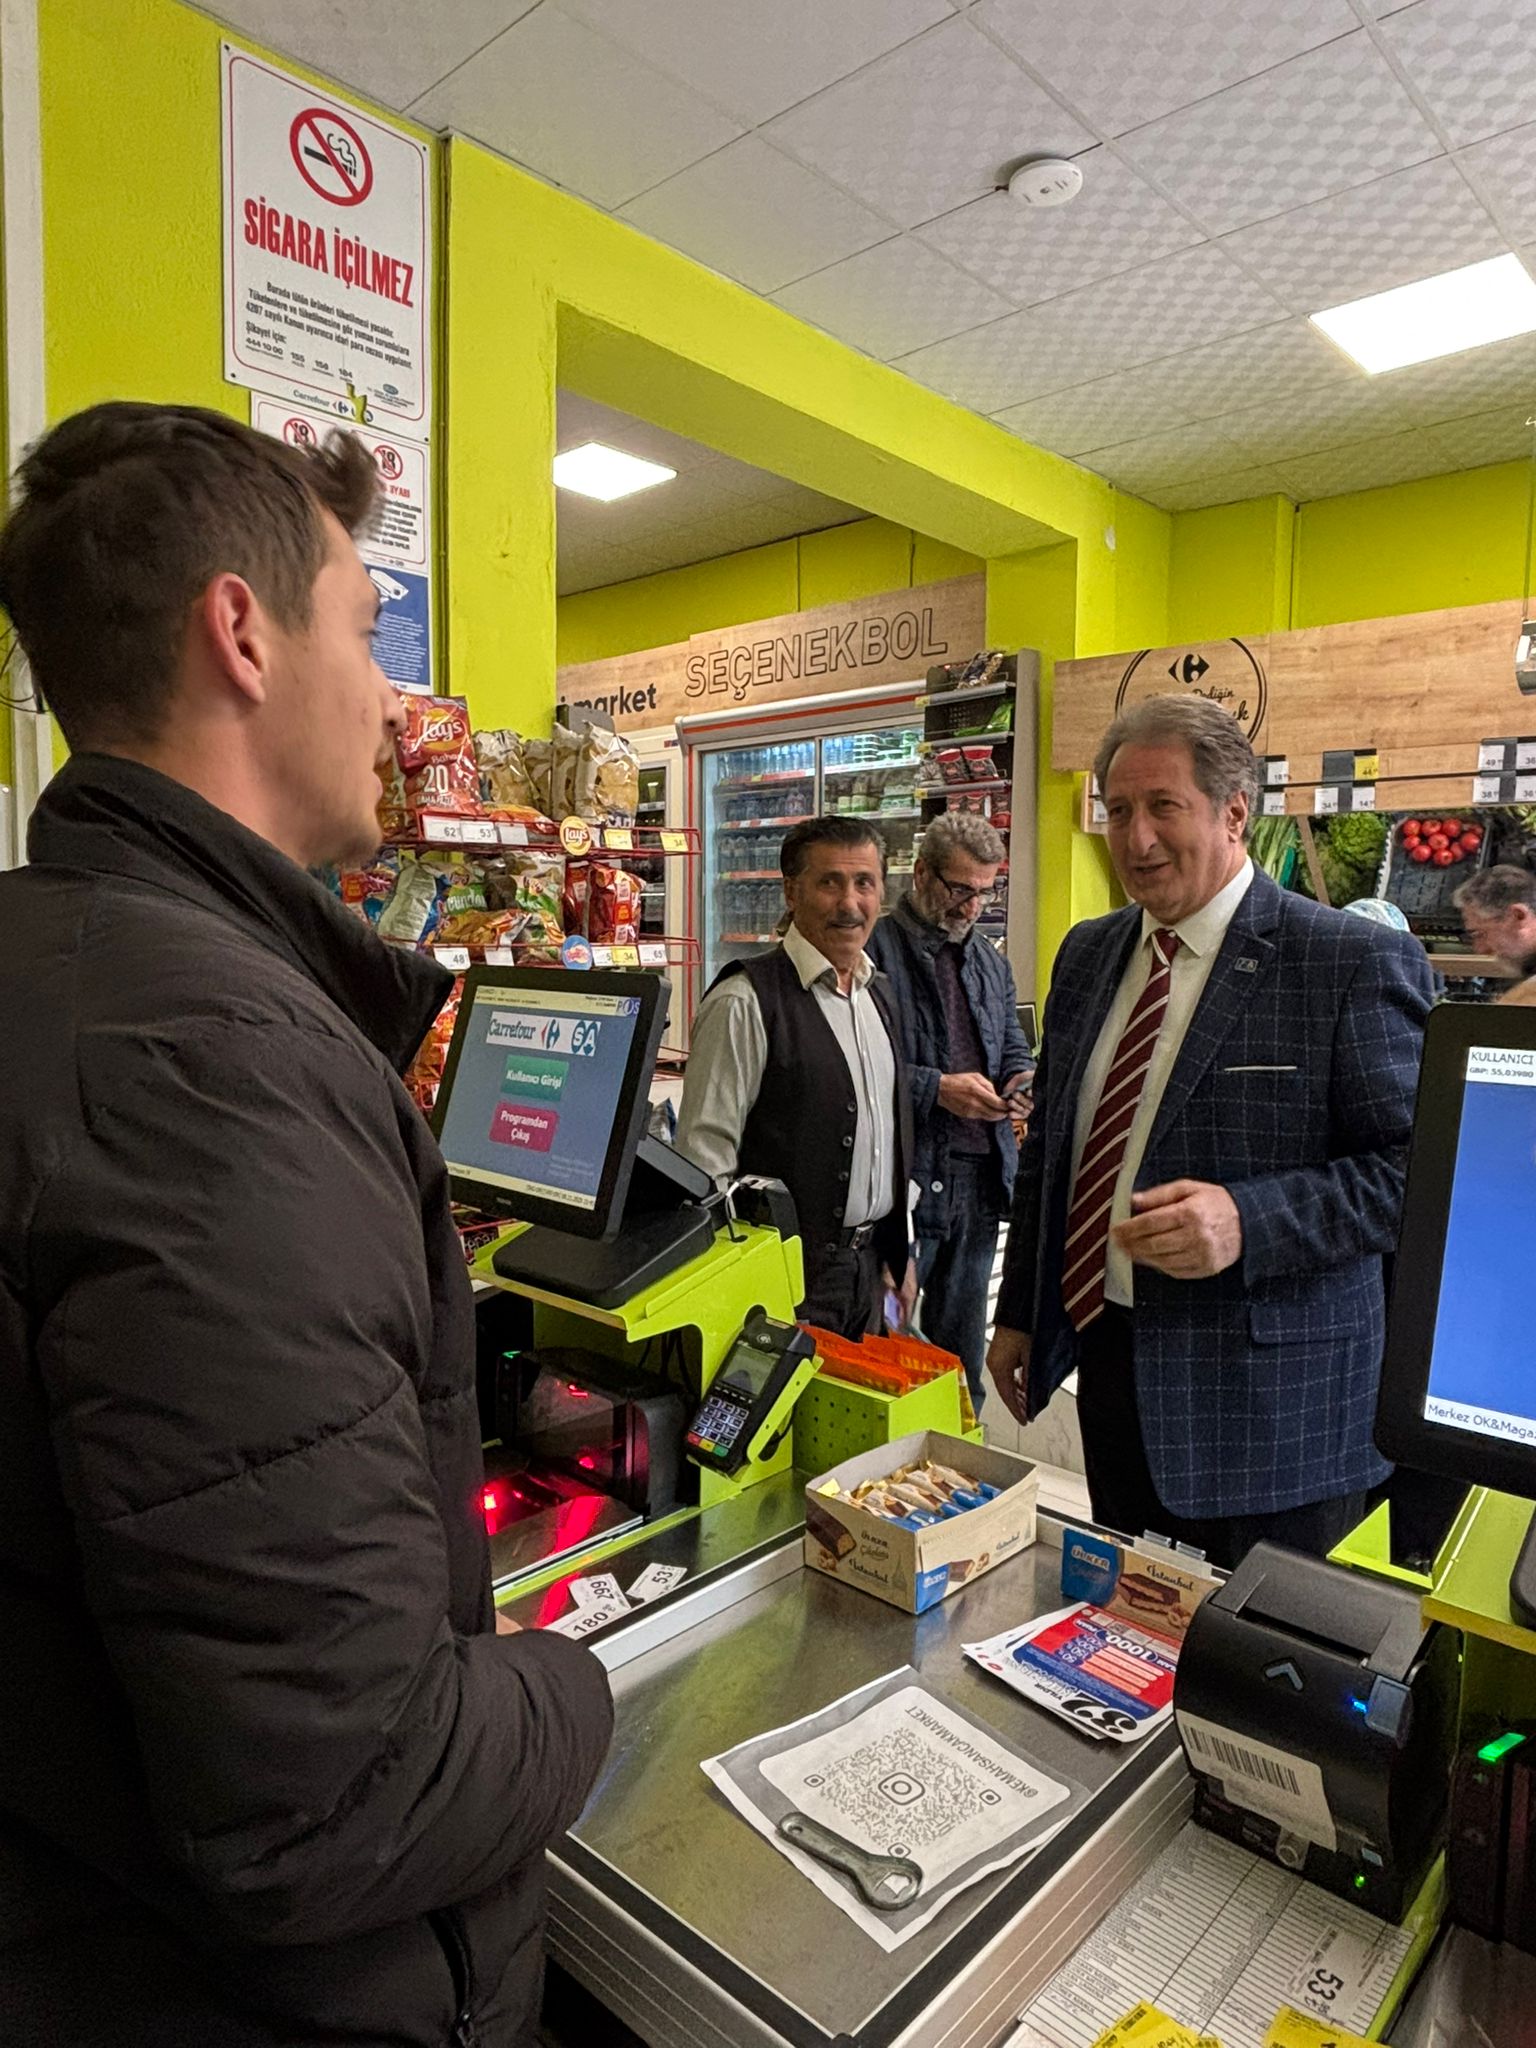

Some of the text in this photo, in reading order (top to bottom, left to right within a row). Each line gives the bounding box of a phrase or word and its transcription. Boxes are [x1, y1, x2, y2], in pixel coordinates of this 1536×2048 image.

[244, 196, 414, 308] SİGARA İÇİLMEZ
[267, 281, 290, 299] Burada
[284, 314, 305, 331] Kanun
[350, 340, 364, 352] para
[289, 305, 297, 315] ve
[342, 324, 353, 335] göz
[354, 330, 374, 343] yuman
[423, 764, 449, 793] 20
[444, 827, 456, 838] 62
[489, 1018, 536, 1040] Carrefour
[1471, 1051, 1534, 1065] KULLANICI
[500, 1110, 548, 1130] Programdan
[1428, 1404, 1536, 1439] Merkez OK&Maga
[651, 1570, 674, 1585] 53
[573, 1612, 608, 1634] 180
[1061, 1690, 1138, 1735] 32
[905, 1706, 1039, 1797] @KEMAHSANCAKMARKET
[1307, 1969, 1344, 2001] 53
